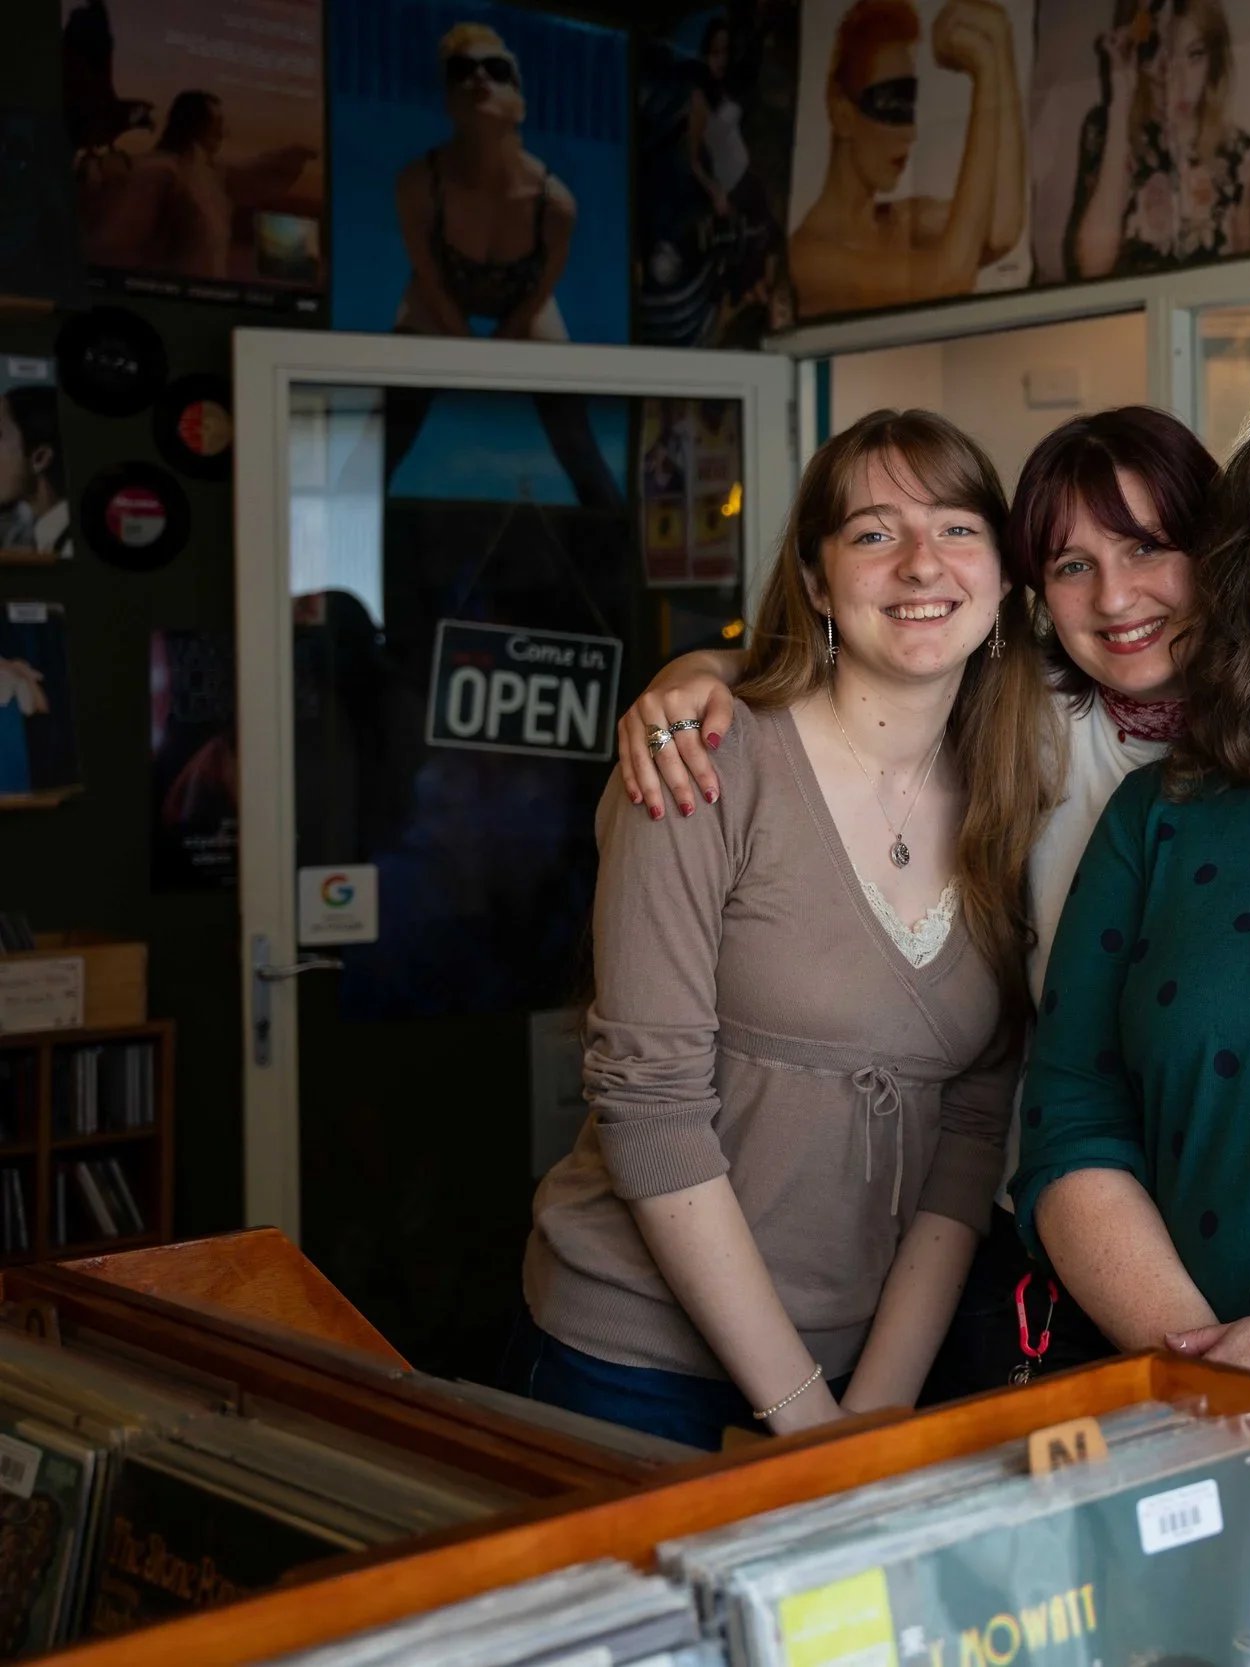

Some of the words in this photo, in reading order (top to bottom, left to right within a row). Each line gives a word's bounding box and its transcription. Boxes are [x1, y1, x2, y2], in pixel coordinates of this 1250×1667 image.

[506, 635, 576, 667] Come
[579, 644, 606, 671] in
[446, 665, 601, 749] OPEN
[321, 874, 354, 908] G
[1048, 1431, 1087, 1471] N
